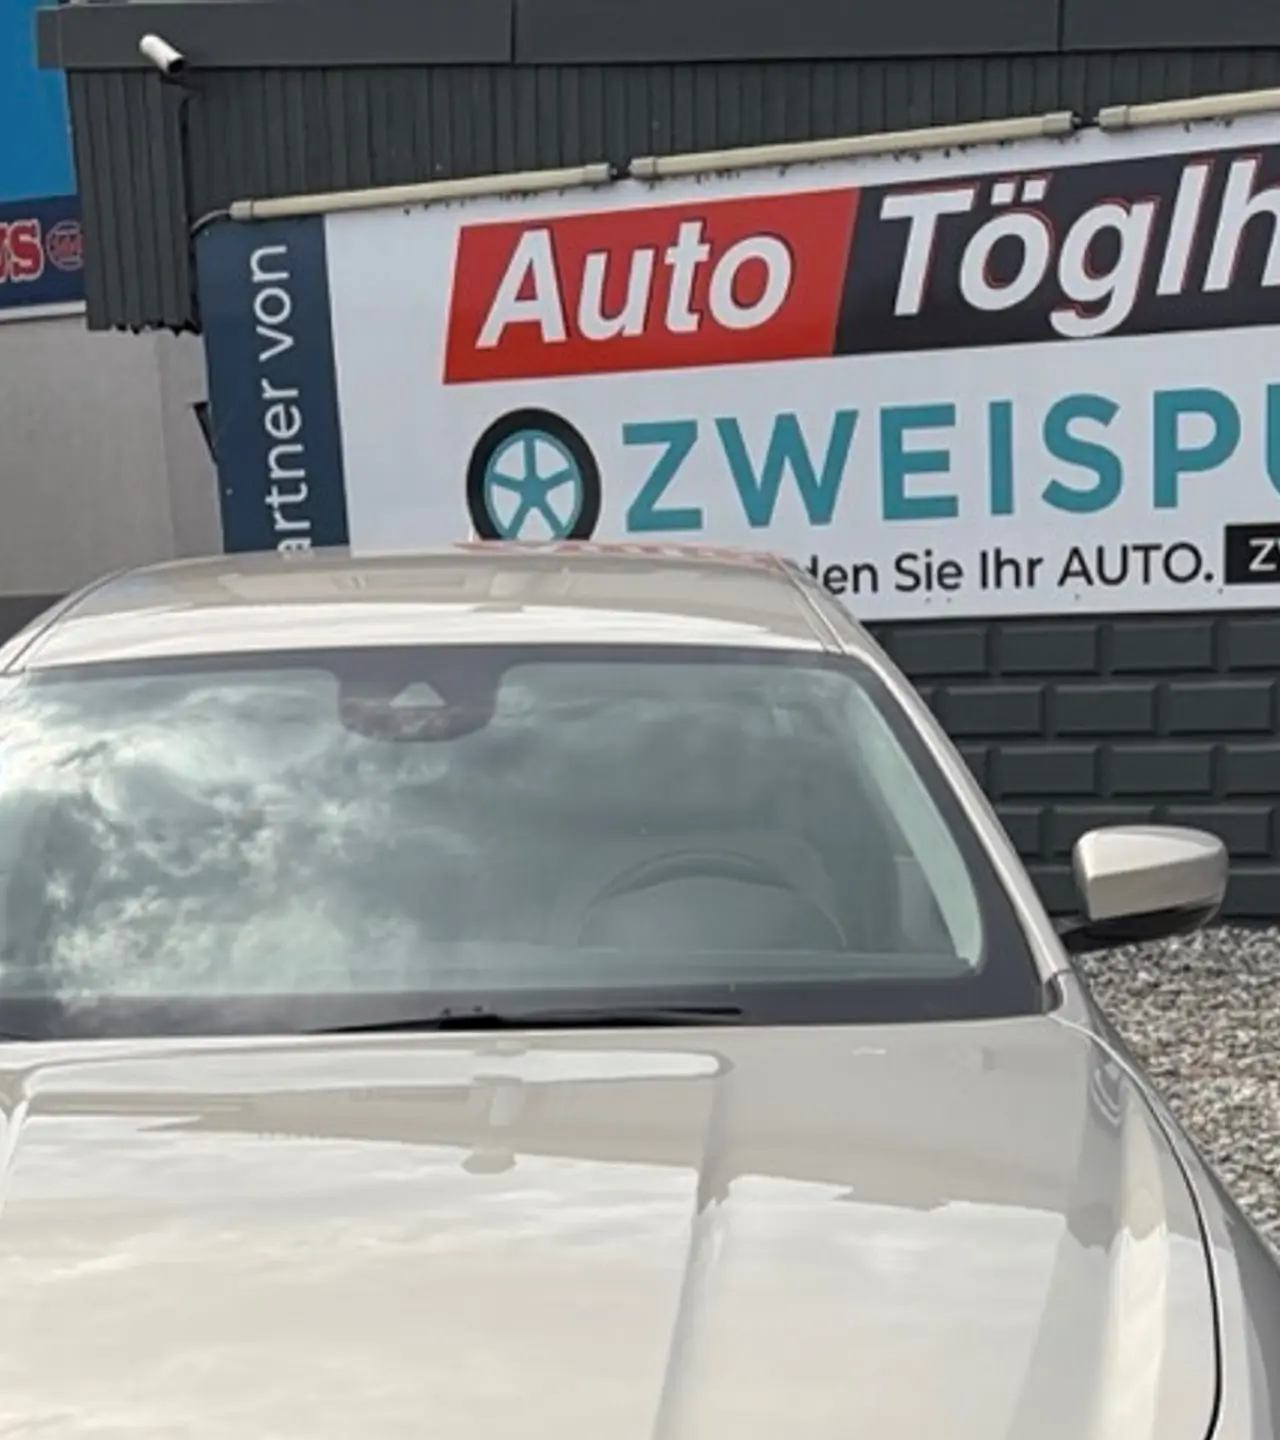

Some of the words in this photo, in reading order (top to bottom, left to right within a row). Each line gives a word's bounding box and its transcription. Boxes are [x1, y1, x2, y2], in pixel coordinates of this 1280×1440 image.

[249, 244, 294, 360] von
[475, 220, 795, 350] Auto
[894, 548, 963, 593] Sie
[978, 550, 1045, 588] Ihr
[1057, 540, 1215, 585] AUTO.
